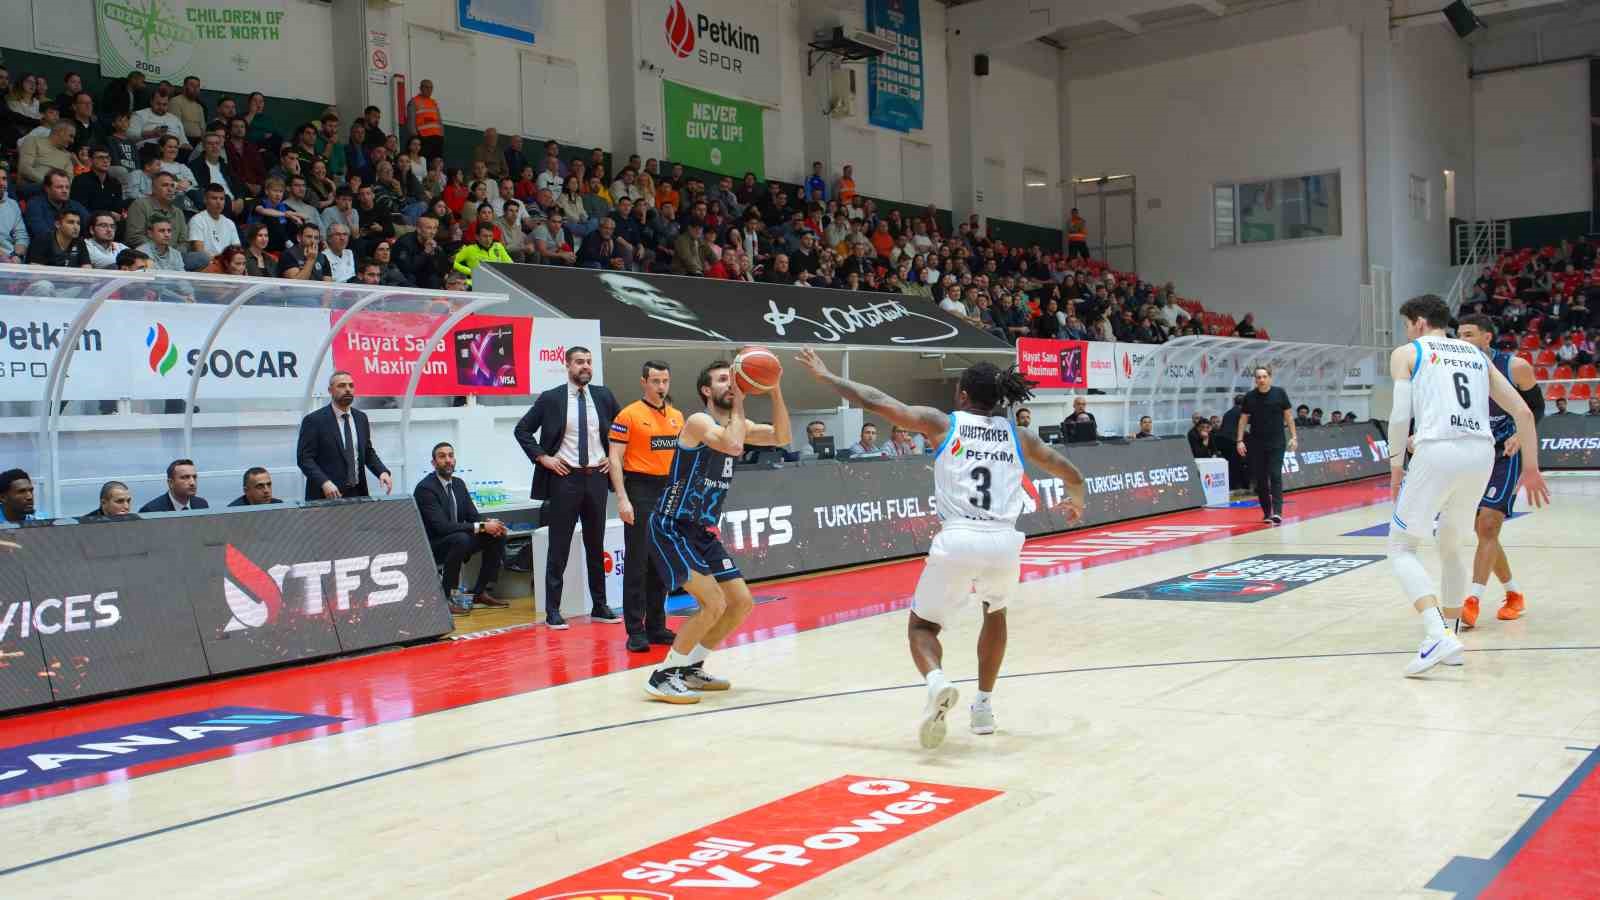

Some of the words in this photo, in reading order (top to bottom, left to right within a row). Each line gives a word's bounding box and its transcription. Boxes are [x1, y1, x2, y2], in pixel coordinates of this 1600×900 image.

[186, 8, 261, 24] CHILDREN
[266, 12, 284, 24] OF
[196, 25, 226, 39] THE
[231, 27, 280, 40] NORTH
[697, 14, 760, 54] Petkim
[699, 49, 743, 73] SPOR
[692, 103, 737, 123] NEVER
[686, 121, 720, 140] GIVE
[722, 124, 743, 142] UP!
[348, 332, 400, 355] Hayat
[404, 334, 446, 352] Saa
[186, 349, 299, 378] SOCAR
[500, 376, 515, 385] VISA
[1453, 372, 1471, 409] 6
[960, 425, 1009, 442] WHITTAKER
[966, 449, 1014, 463] PETKIM
[969, 466, 991, 511] 3
[1085, 474, 1123, 495] TURKISH
[1124, 471, 1149, 489] FUEL
[1149, 466, 1189, 486] SERVICES
[727, 505, 793, 550] TFS
[814, 501, 881, 529] TURKISH
[887, 497, 925, 520] FUEL
[288, 551, 409, 616] TFS
[671, 791, 953, 890] V-Power
[622, 836, 756, 884] Shell
